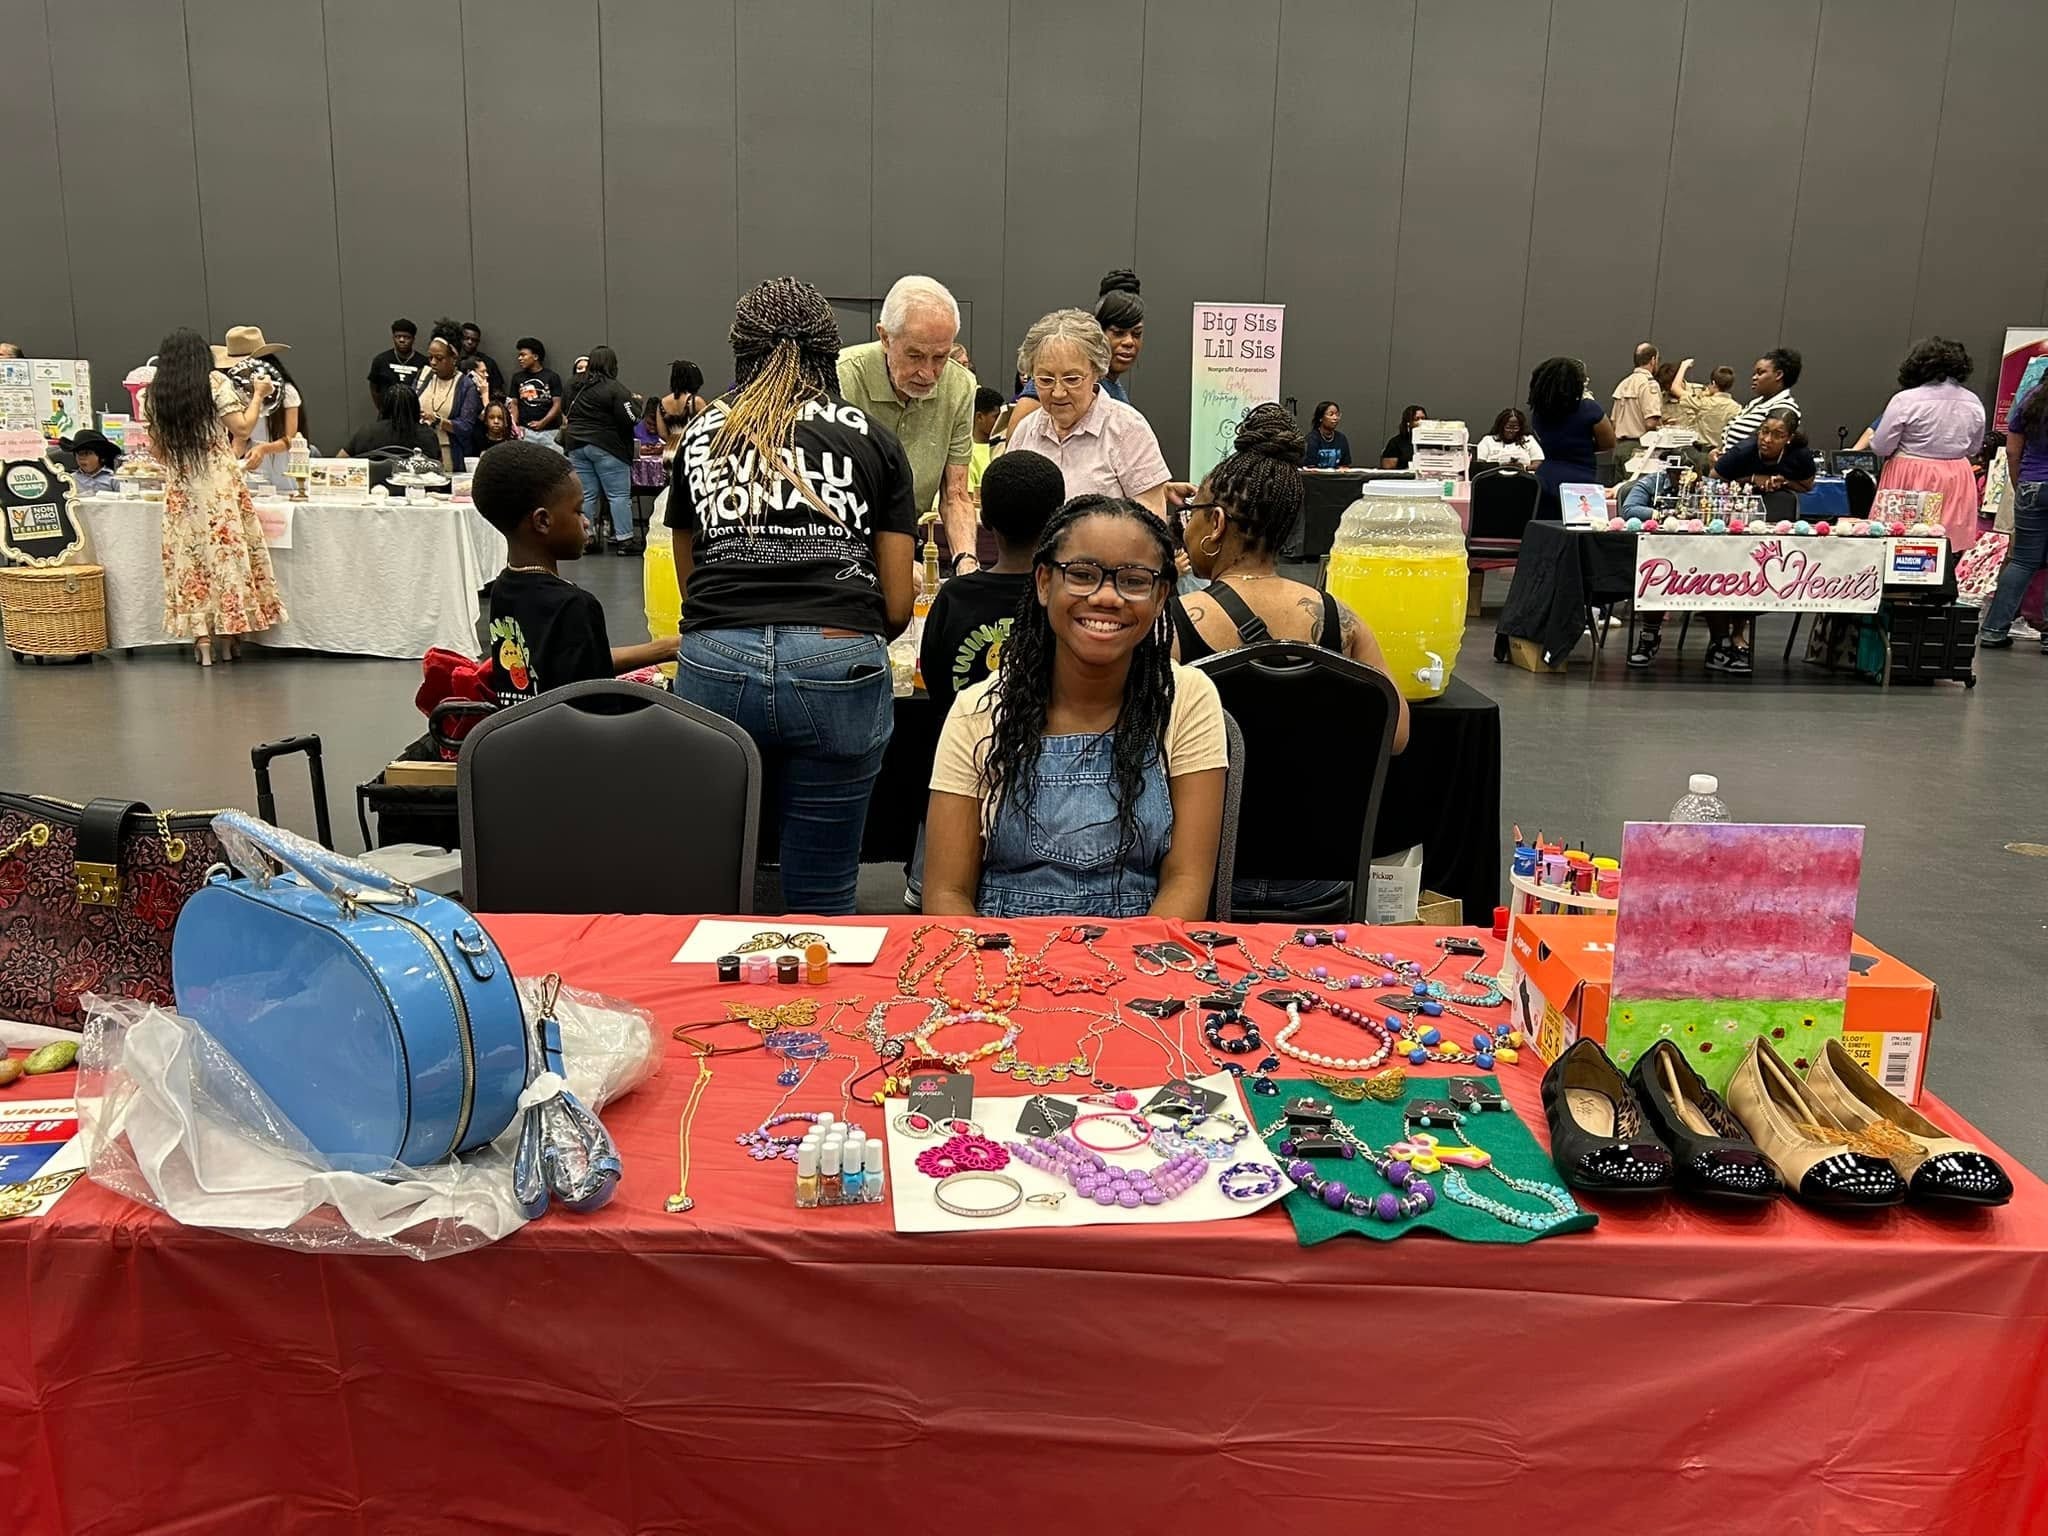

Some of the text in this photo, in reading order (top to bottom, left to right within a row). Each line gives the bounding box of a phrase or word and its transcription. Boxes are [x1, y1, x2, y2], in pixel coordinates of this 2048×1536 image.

[1202, 312, 1277, 336] Big Sis
[1204, 339, 1275, 359] Lil Sis
[1207, 366, 1234, 374] Nonprofit
[684, 434, 711, 475] IS
[14, 474, 38, 482] USDA
[689, 446, 854, 504] REVOLU
[33, 506, 54, 514] NON
[13, 524, 59, 533] VERIFIED
[768, 525, 807, 537] them
[809, 523, 826, 536] lie
[828, 525, 844, 537] to
[1638, 558, 1765, 598] Princess
[1372, 872, 1394, 881] Pickup
[1854, 1049, 1872, 1058] SIZE
[3, 1106, 78, 1116] VENDO
[0, 1121, 63, 1133] USE OF
